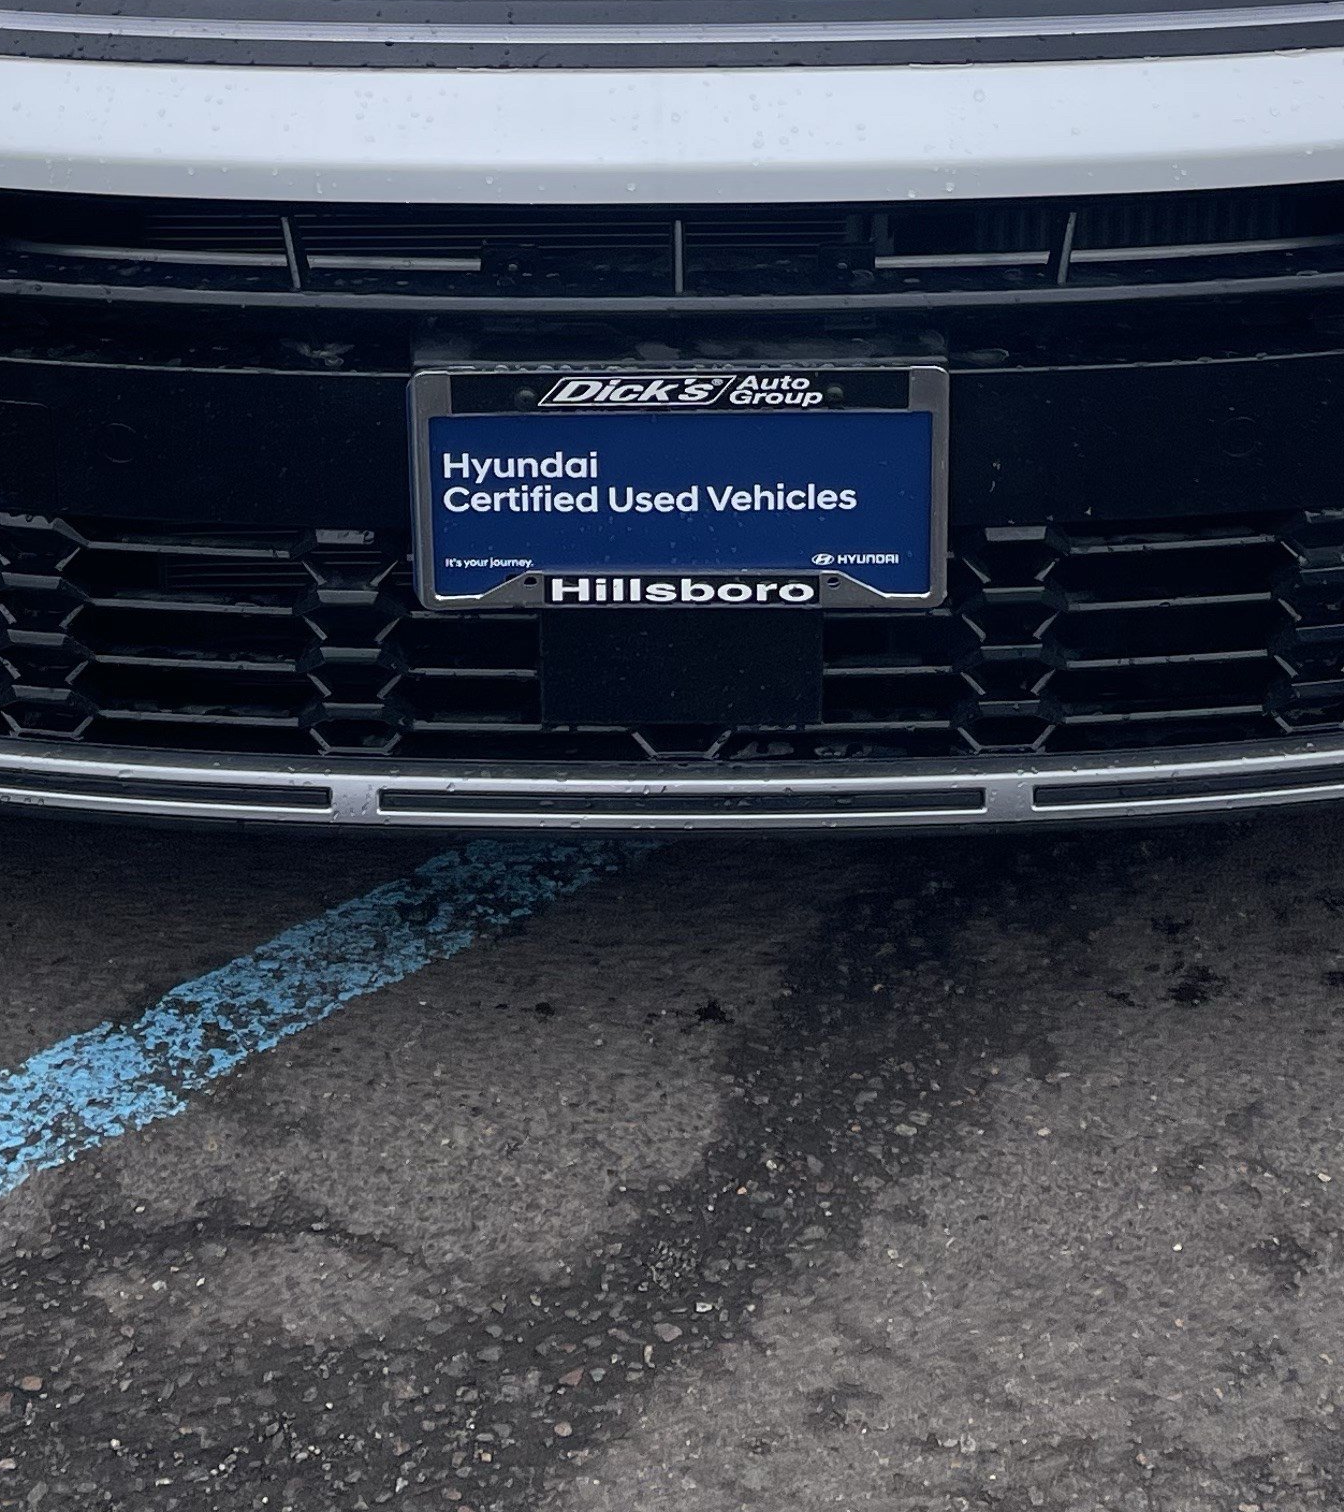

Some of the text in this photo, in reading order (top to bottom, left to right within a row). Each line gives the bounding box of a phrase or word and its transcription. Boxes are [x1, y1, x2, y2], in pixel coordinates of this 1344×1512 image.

[553, 375, 810, 402] Dick's Auto
[729, 390, 823, 407] Group
[442, 451, 598, 484] Hyundai
[443, 483, 857, 513] Certified Used Vehicles
[445, 557, 462, 568] It's
[463, 558, 489, 569] your
[837, 553, 900, 565] HYUNDAI
[551, 577, 816, 602] Hillsboro
